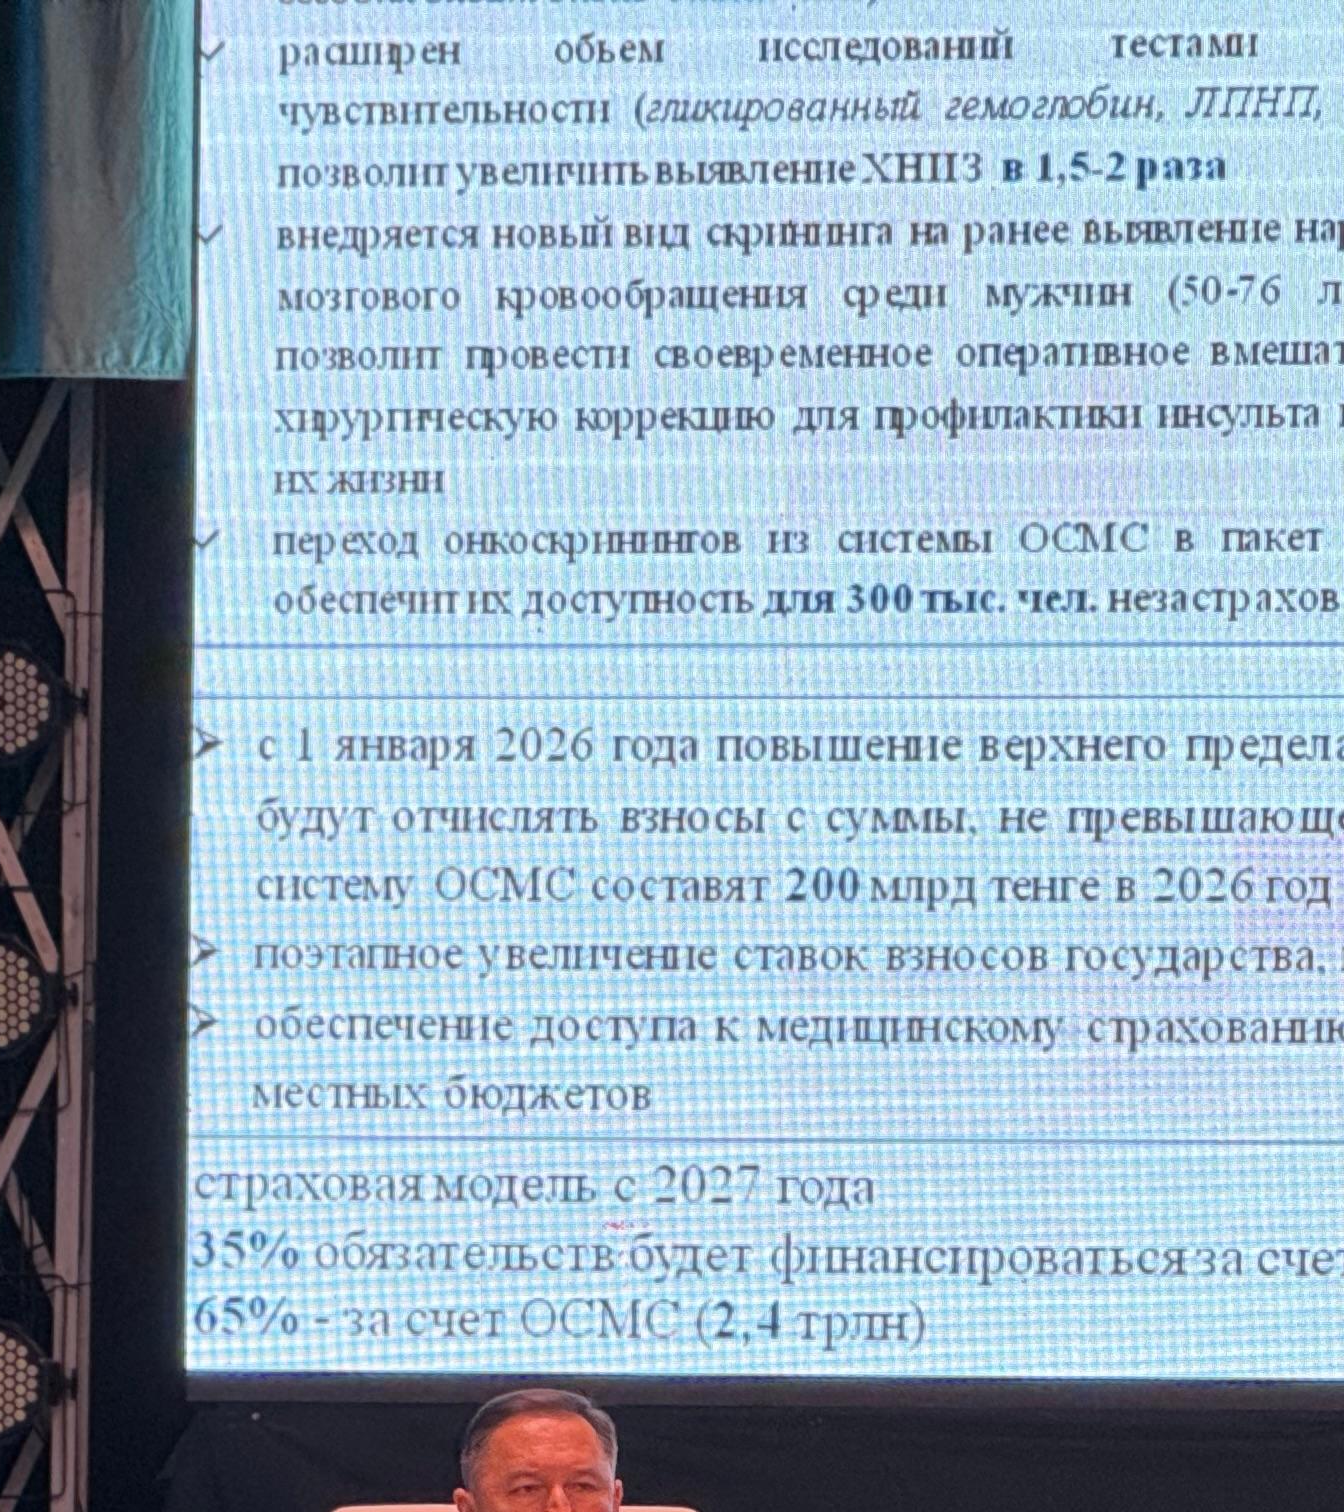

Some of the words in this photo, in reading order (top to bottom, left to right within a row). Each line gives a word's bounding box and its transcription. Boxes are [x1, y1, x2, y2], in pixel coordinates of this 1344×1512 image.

[279, 41, 461, 77] расширен
[759, 28, 1014, 65] исследований
[1112, 33, 1258, 59] тестами
[279, 99, 610, 135] чувствительности
[634, 89, 921, 132] (гликированный
[278, 162, 449, 189] позволит
[456, 161, 649, 196] увеличить
[656, 159, 856, 185] выявление
[1003, 158, 1024, 182] в
[1039, 151, 1125, 183] 1,5-2
[1136, 157, 1226, 191] раза
[277, 225, 479, 259] внедряется
[493, 216, 613, 249] новый
[624, 223, 690, 251] вид
[910, 221, 949, 246] на
[963, 220, 1070, 255] ранее
[1083, 218, 1281, 245] выявление
[1295, 218, 1344, 252] на
[278, 287, 461, 312] мозгового
[497, 278, 807, 320] кровообращения
[843, 284, 946, 319] среди
[986, 282, 1131, 317] мужчин
[1167, 274, 1281, 313] (50-76
[275, 346, 443, 372] позволит
[466, 345, 630, 380] провести
[654, 343, 933, 378] своевременное
[956, 342, 1190, 377] оперативное
[276, 407, 558, 442] хирургическую
[576, 406, 775, 441] коррекцию
[792, 406, 859, 435] для
[875, 398, 1141, 440] профилактики
[1158, 404, 1320, 437] инсульта
[274, 470, 319, 495] их
[327, 469, 444, 494] жизни
[273, 530, 419, 565] переход
[768, 530, 809, 554] из
[837, 529, 992, 554] системы
[1018, 521, 1149, 553] ОСМС
[1175, 529, 1195, 552] в
[1222, 528, 1323, 553] пакет
[274, 583, 459, 615] обеспечит
[467, 590, 512, 615] их
[521, 589, 755, 623] доступность
[763, 590, 835, 617] для
[847, 583, 913, 613] 300
[921, 590, 1005, 613] тыс.
[1018, 589, 1097, 613] чел.
[1108, 588, 1340, 622] незастрахов
[258, 735, 276, 761] с
[299, 727, 312, 762] 1
[336, 735, 476, 771] января
[496, 725, 594, 763] 2026
[613, 735, 698, 768] года
[717, 735, 963, 763] повышение
[980, 735, 1166, 772] верхнего
[256, 796, 375, 842] будут
[392, 806, 599, 834] отчислять
[620, 807, 765, 834] взносы
[786, 806, 806, 833] с
[999, 807, 1048, 834] не
[1067, 807, 1344, 843] превышающ
[256, 874, 415, 910] систему
[434, 865, 577, 903] ОСМС
[591, 875, 770, 903] составят
[786, 867, 860, 903] 200
[870, 876, 977, 913] млрд
[991, 876, 1100, 903] тенге
[1116, 876, 1136, 903] в
[1154, 866, 1254, 903] 2026
[254, 943, 464, 971] поэтапное
[478, 944, 717, 979] увеличение
[733, 944, 868, 972] ставок
[886, 944, 1048, 973] взносов
[255, 1004, 514, 1043] обеспечение
[529, 1015, 697, 1051] доступа
[715, 1016, 739, 1043] к
[757, 1016, 1064, 1052] медицинскому
[253, 1082, 427, 1110] местных
[443, 1074, 652, 1116] бюджетов
[194, 1172, 424, 1213] страховая
[433, 1174, 598, 1208] модель
[613, 1175, 636, 1204] с
[655, 1164, 760, 1205] 2027
[777, 1176, 874, 1211] года
[192, 1229, 300, 1270] 35%
[314, 1229, 616, 1273] обязательств
[629, 1231, 752, 1284] будет
[770, 1231, 1187, 1287] финансироваться
[1196, 1247, 1243, 1277] за
[193, 1295, 299, 1336] 65%
[344, 1307, 390, 1337] за
[405, 1308, 506, 1339] счет
[520, 1297, 681, 1341] ОСМС
[695, 1300, 780, 1349] (2,4
[798, 1300, 926, 1352] трлн)
